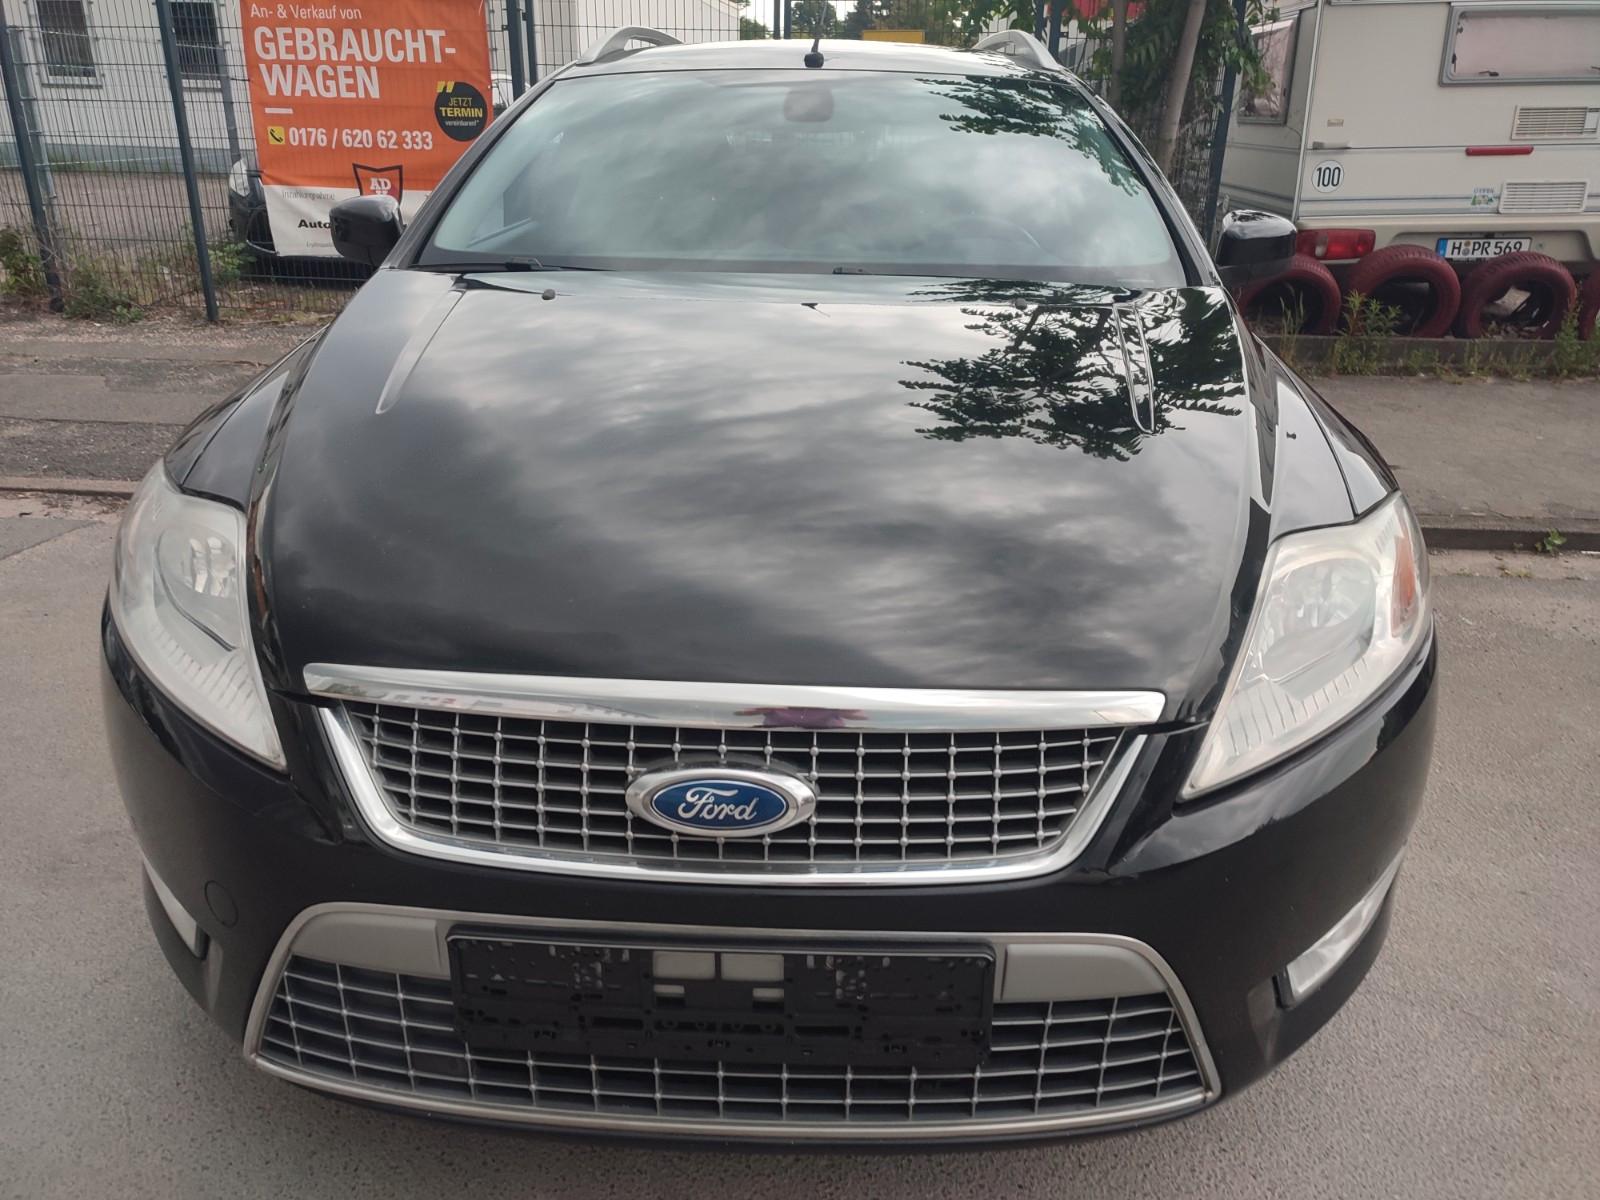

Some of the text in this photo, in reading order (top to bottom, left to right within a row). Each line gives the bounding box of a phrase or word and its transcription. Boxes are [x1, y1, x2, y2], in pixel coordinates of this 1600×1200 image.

[250, 3, 362, 19] An- & Verkauf von
[253, 26, 456, 64] GEBRAUCHT-
[258, 63, 380, 99] WAGEN
[440, 107, 483, 118] TERMIN
[448, 97, 472, 107] JETZT
[289, 127, 433, 150] 0176 / 620 62 333
[370, 177, 392, 191] AD
[1316, 166, 1341, 188] 100
[678, 786, 759, 820] Ford
